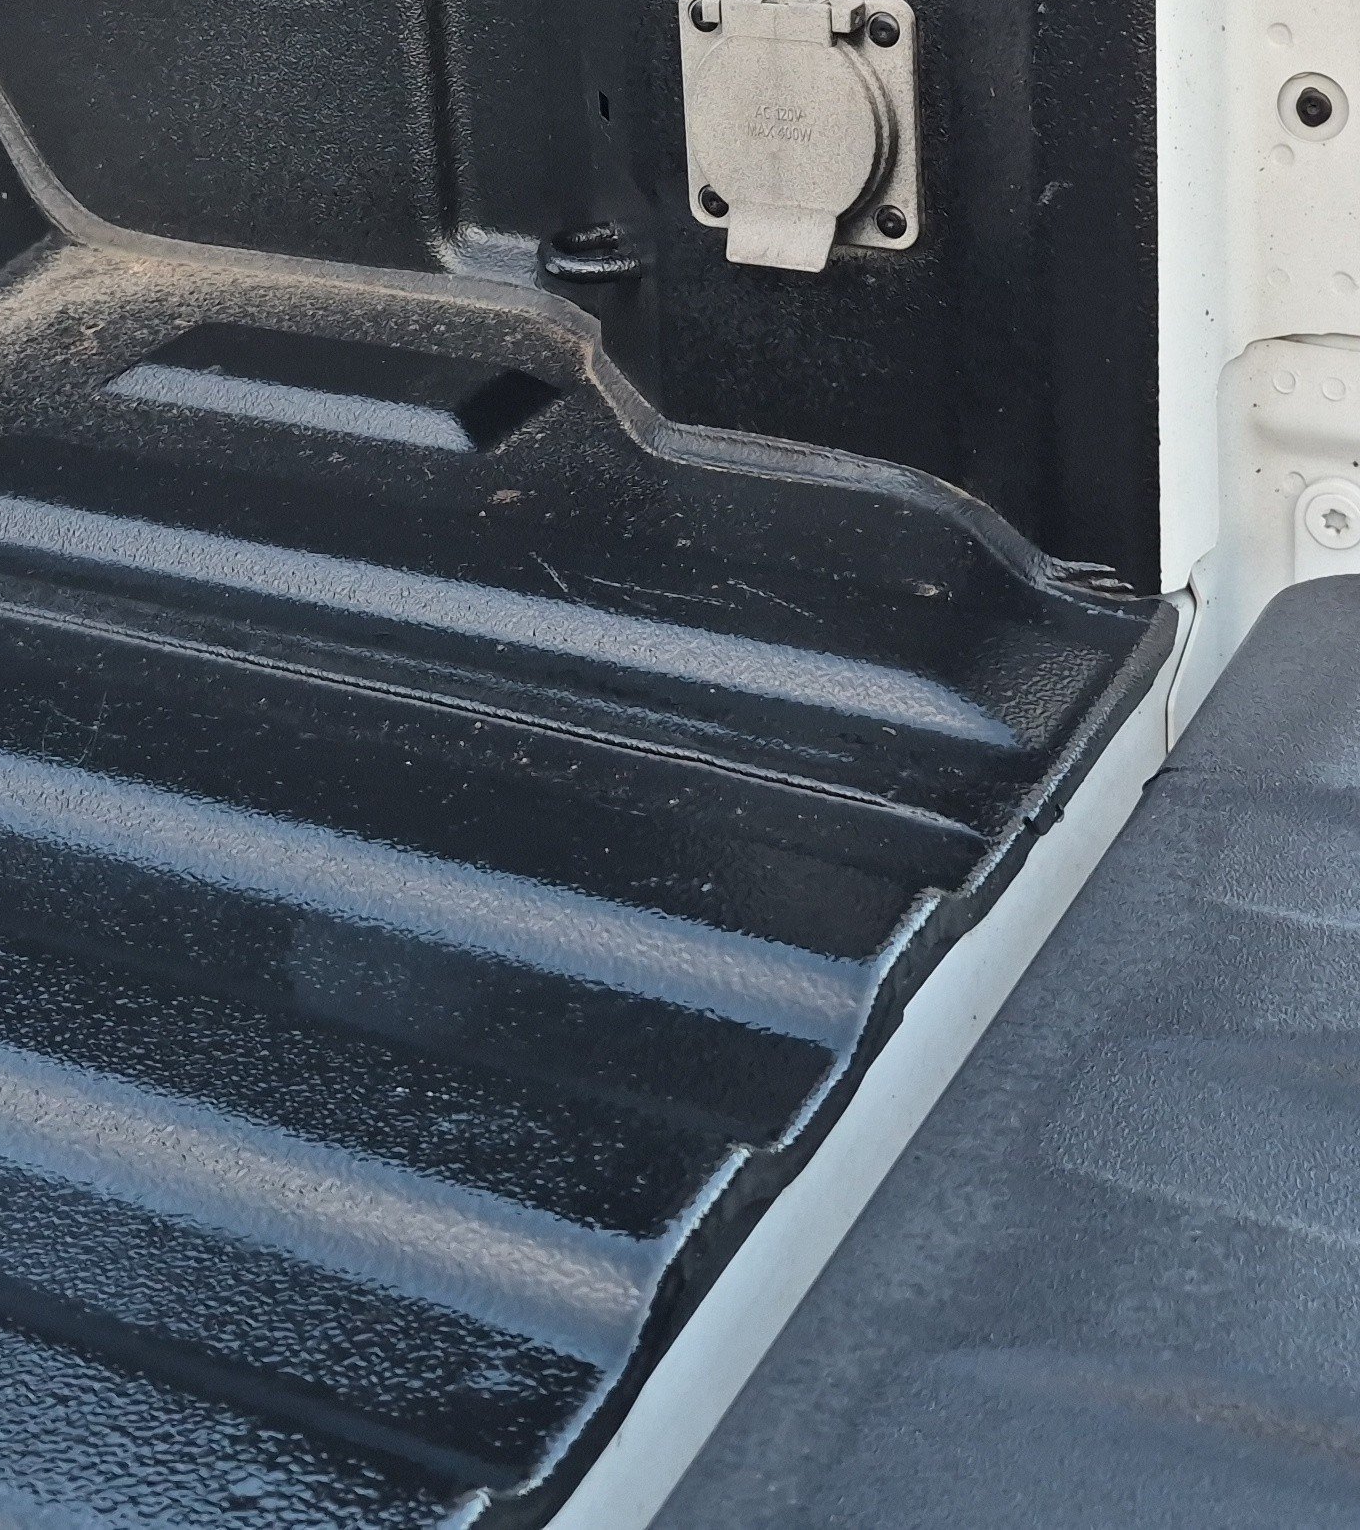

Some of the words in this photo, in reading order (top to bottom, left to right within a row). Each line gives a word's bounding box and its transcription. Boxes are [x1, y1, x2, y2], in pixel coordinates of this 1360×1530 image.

[754, 105, 771, 120] AC
[776, 107, 803, 123] 120V
[747, 121, 775, 139] MAX
[777, 126, 813, 142] 400W
